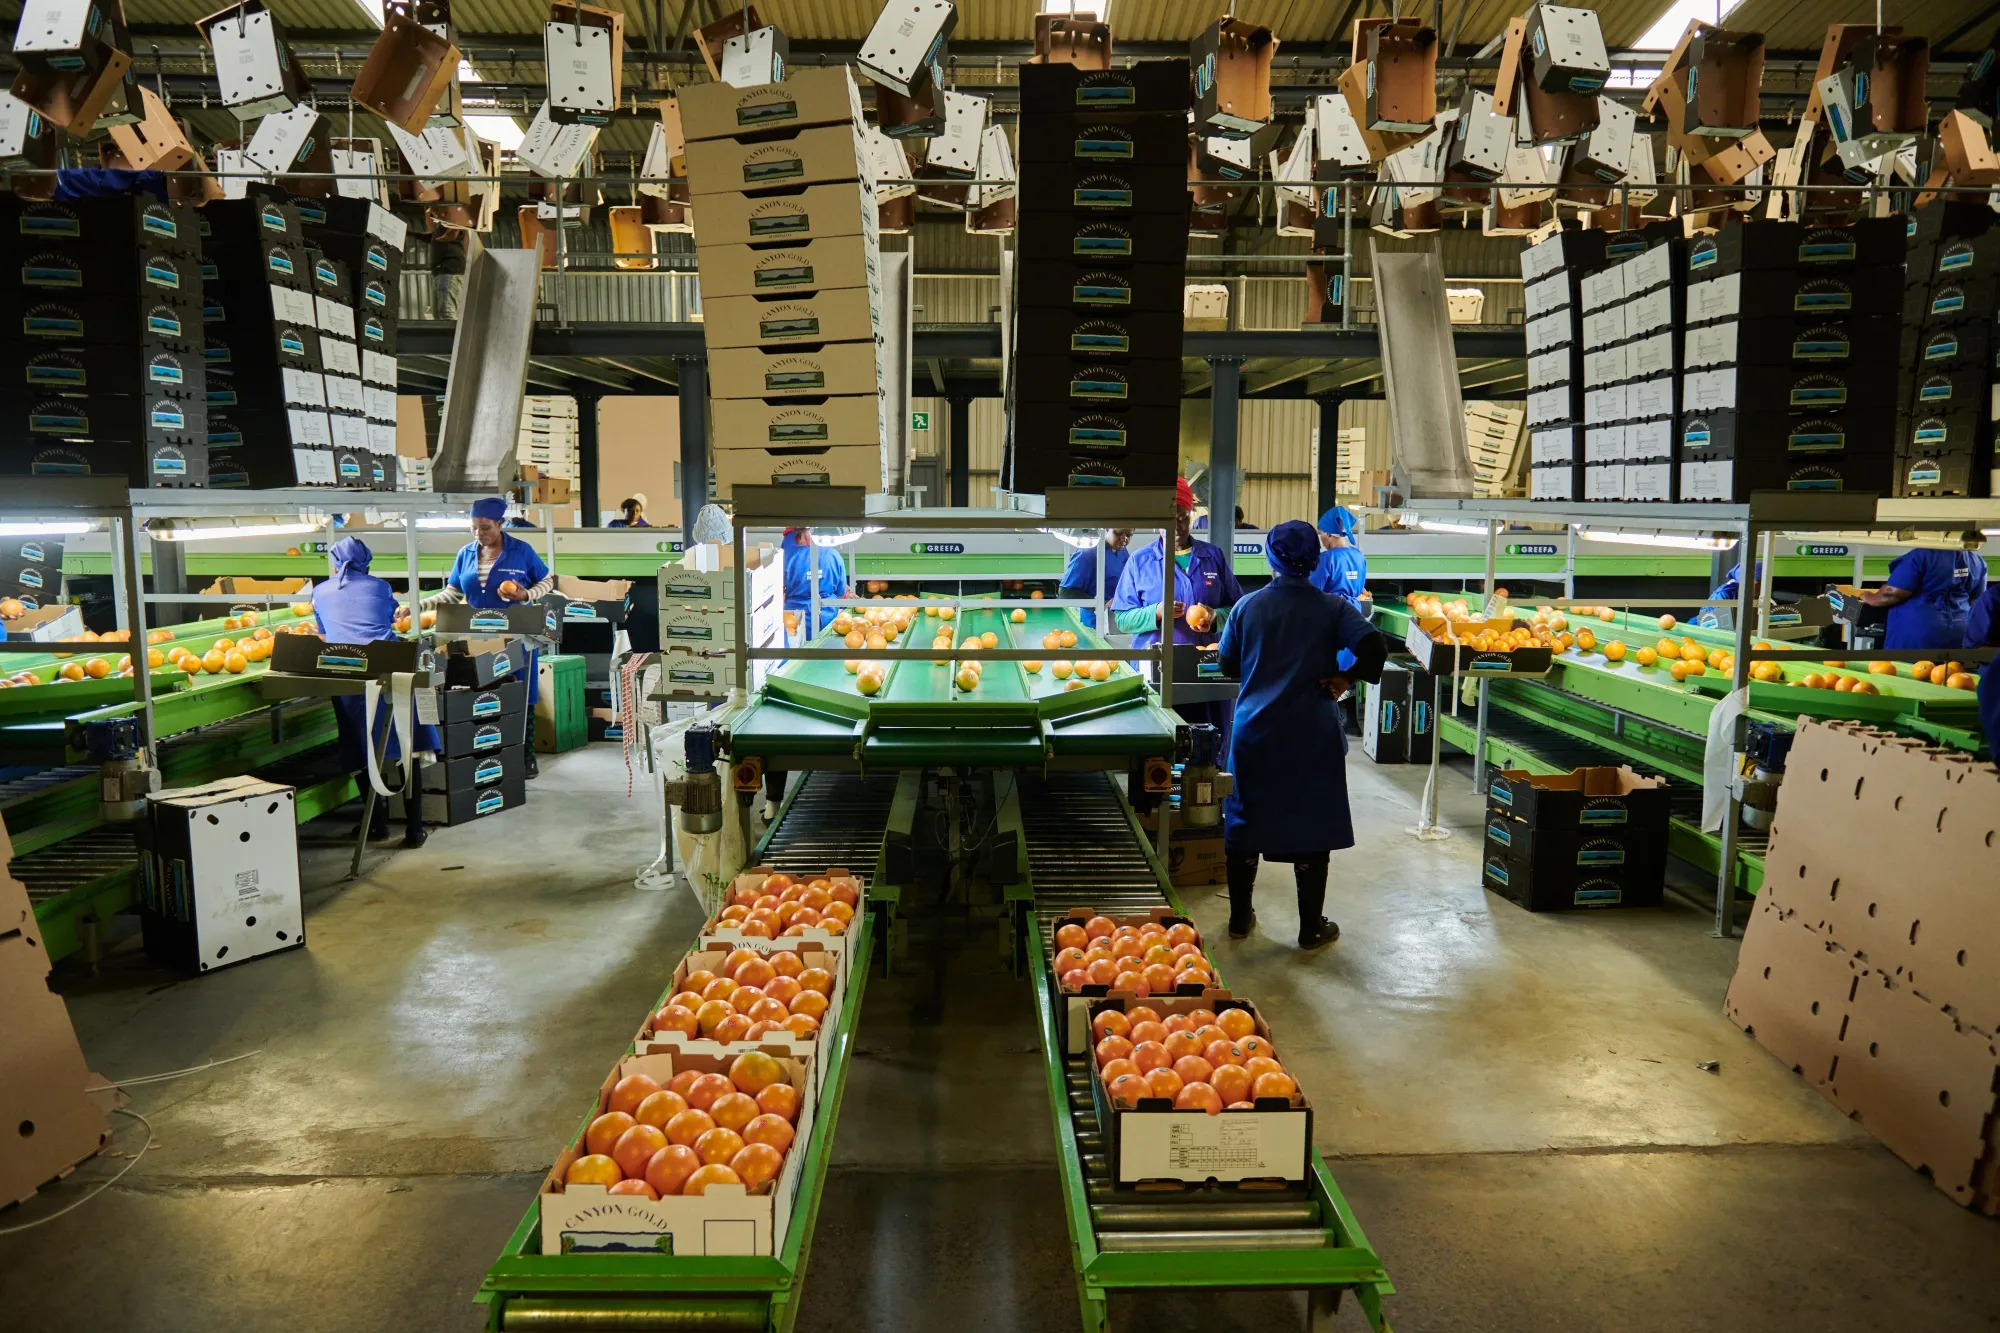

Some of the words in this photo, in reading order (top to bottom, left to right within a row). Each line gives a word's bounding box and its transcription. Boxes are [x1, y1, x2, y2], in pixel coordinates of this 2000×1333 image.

[1079, 71, 1110, 88] CANYON
[1111, 72, 1133, 87] GOLD
[738, 88, 768, 107] CANYON
[769, 88, 793, 100] GOLD
[1078, 124, 1109, 140] CANYON
[1110, 126, 1132, 141] GOLD
[744, 146, 775, 164] CANYON
[776, 146, 799, 158] GOLD
[1077, 173, 1108, 189] CANYON
[1109, 175, 1131, 190] GOLD
[751, 200, 781, 218] CANYON
[782, 201, 805, 213] GOLD
[1076, 222, 1108, 238] CANYON
[1109, 223, 1130, 239] GOLD
[756, 252, 786, 269] CANYON
[787, 253, 810, 265] GOLD
[1076, 271, 1107, 286] CANYON
[1108, 272, 1129, 288] GOLD
[761, 304, 792, 321] CANYON
[793, 305, 816, 317] GOLD
[1074, 319, 1106, 334] CANYON
[1106, 321, 1127, 336] GOLD
[767, 357, 797, 373] CANYON
[799, 358, 821, 371] GOLD
[1073, 366, 1105, 381] CANYON
[1105, 367, 1126, 382] GOLD
[31, 400, 62, 415] CANYON
[64, 402, 86, 417] GOLD
[771, 409, 801, 424] CANYON
[803, 410, 825, 423] GOLD
[1072, 413, 1103, 428] CANYON
[1104, 415, 1125, 430] GOLD
[33, 448, 64, 462] CANYON
[66, 450, 88, 464] GOLD
[773, 458, 804, 474] CANYON
[805, 459, 827, 472] GOLD
[1071, 460, 1102, 475] CANYON
[1103, 462, 1123, 476] GOLD
[927, 544, 961, 552] GREEFA
[1233, 545, 1259, 553] REEFA
[1812, 546, 1845, 554] GREEFA
[667, 573, 692, 584] CANYON
[692, 574, 710, 586] GOLD
[668, 614, 692, 625] CANYON
[693, 616, 710, 627] GOLD
[321, 644, 349, 655] CANYON
[349, 645, 367, 658] GOLD
[1473, 652, 1497, 662] CANYON
[1497, 653, 1512, 663] GOLD
[671, 659, 694, 670] CANYON
[695, 660, 712, 671] GOLD
[1583, 797, 1609, 810] CANYON
[1610, 798, 1627, 810] GOLD
[1580, 838, 1606, 851] CANYON
[1607, 839, 1624, 850] GOLD
[564, 1203, 623, 1230] CANYON
[627, 1205, 668, 1231] GOLD
